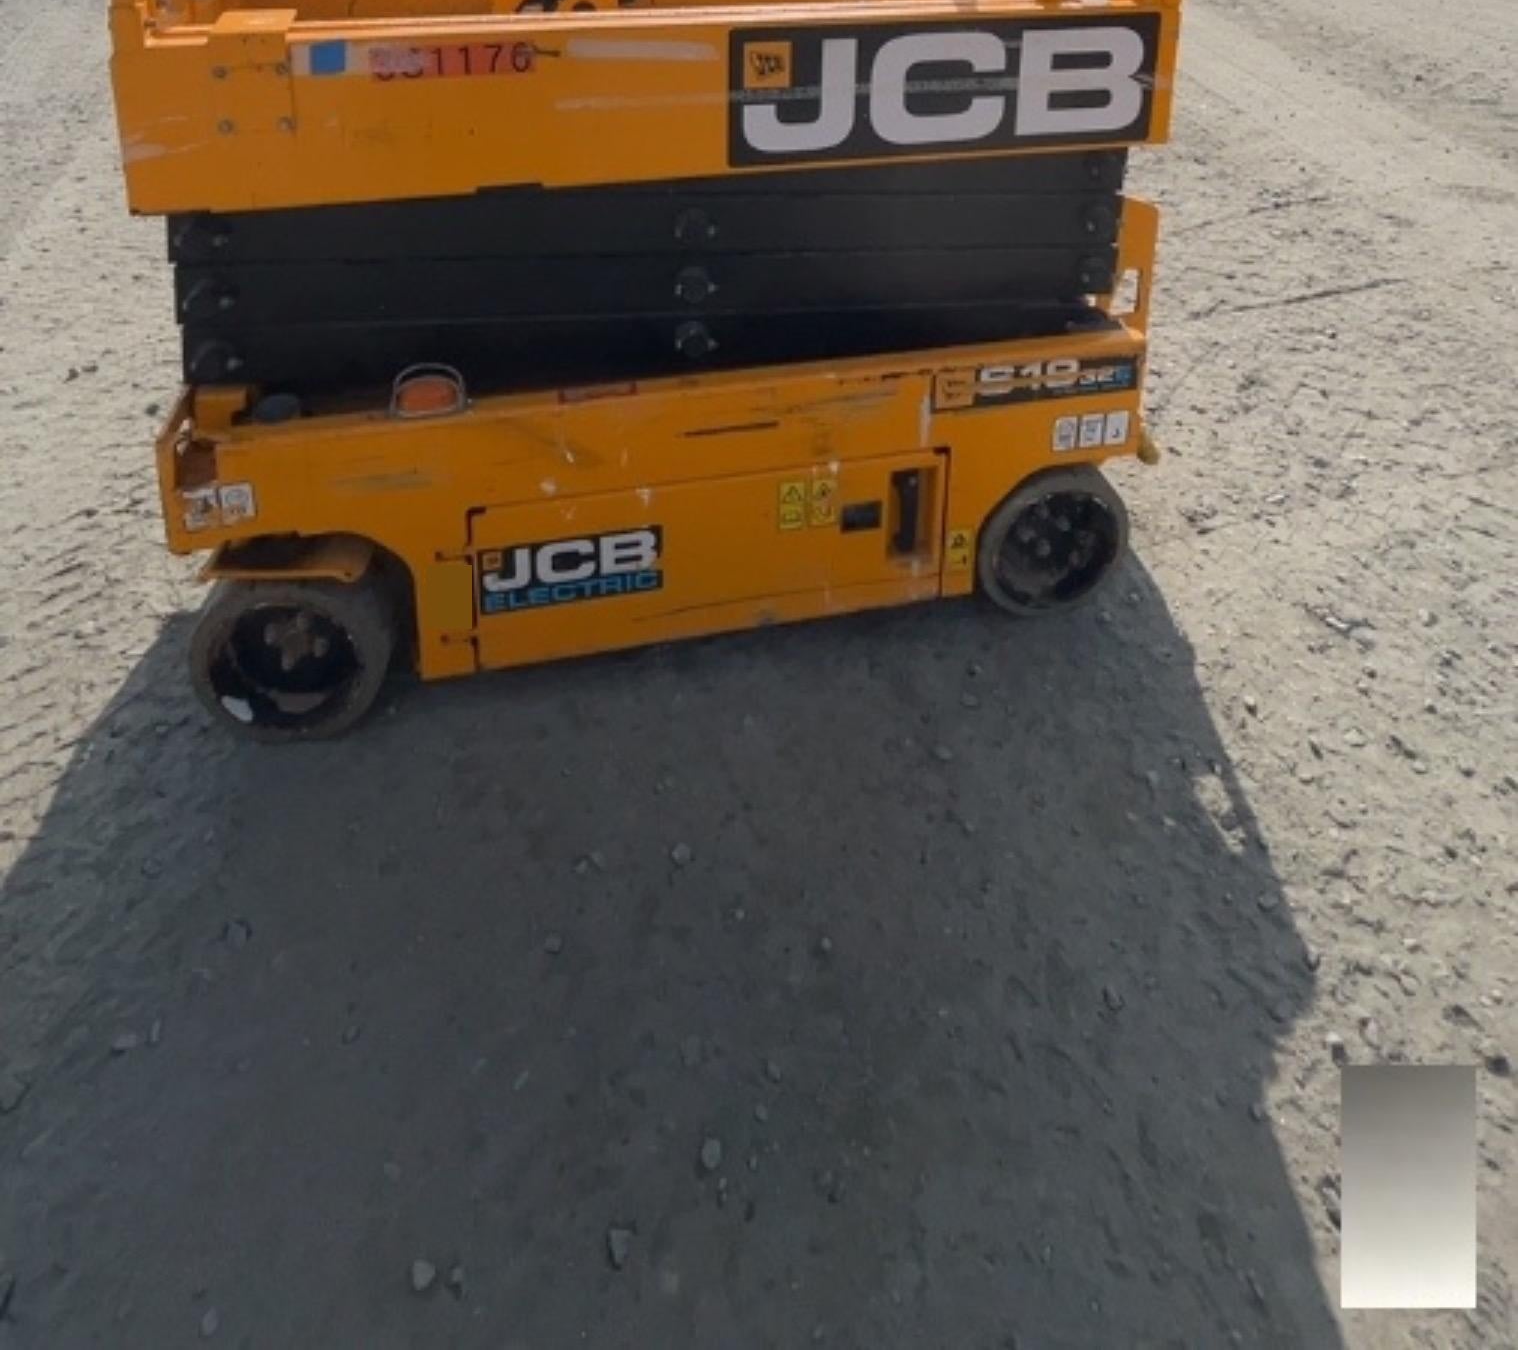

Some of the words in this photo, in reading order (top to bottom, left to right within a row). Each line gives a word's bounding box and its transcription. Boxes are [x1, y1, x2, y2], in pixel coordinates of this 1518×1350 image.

[370, 41, 532, 82] 1176
[742, 26, 1145, 152] JCB
[482, 529, 657, 592] JCB
[484, 571, 658, 611] ELECTRIC
